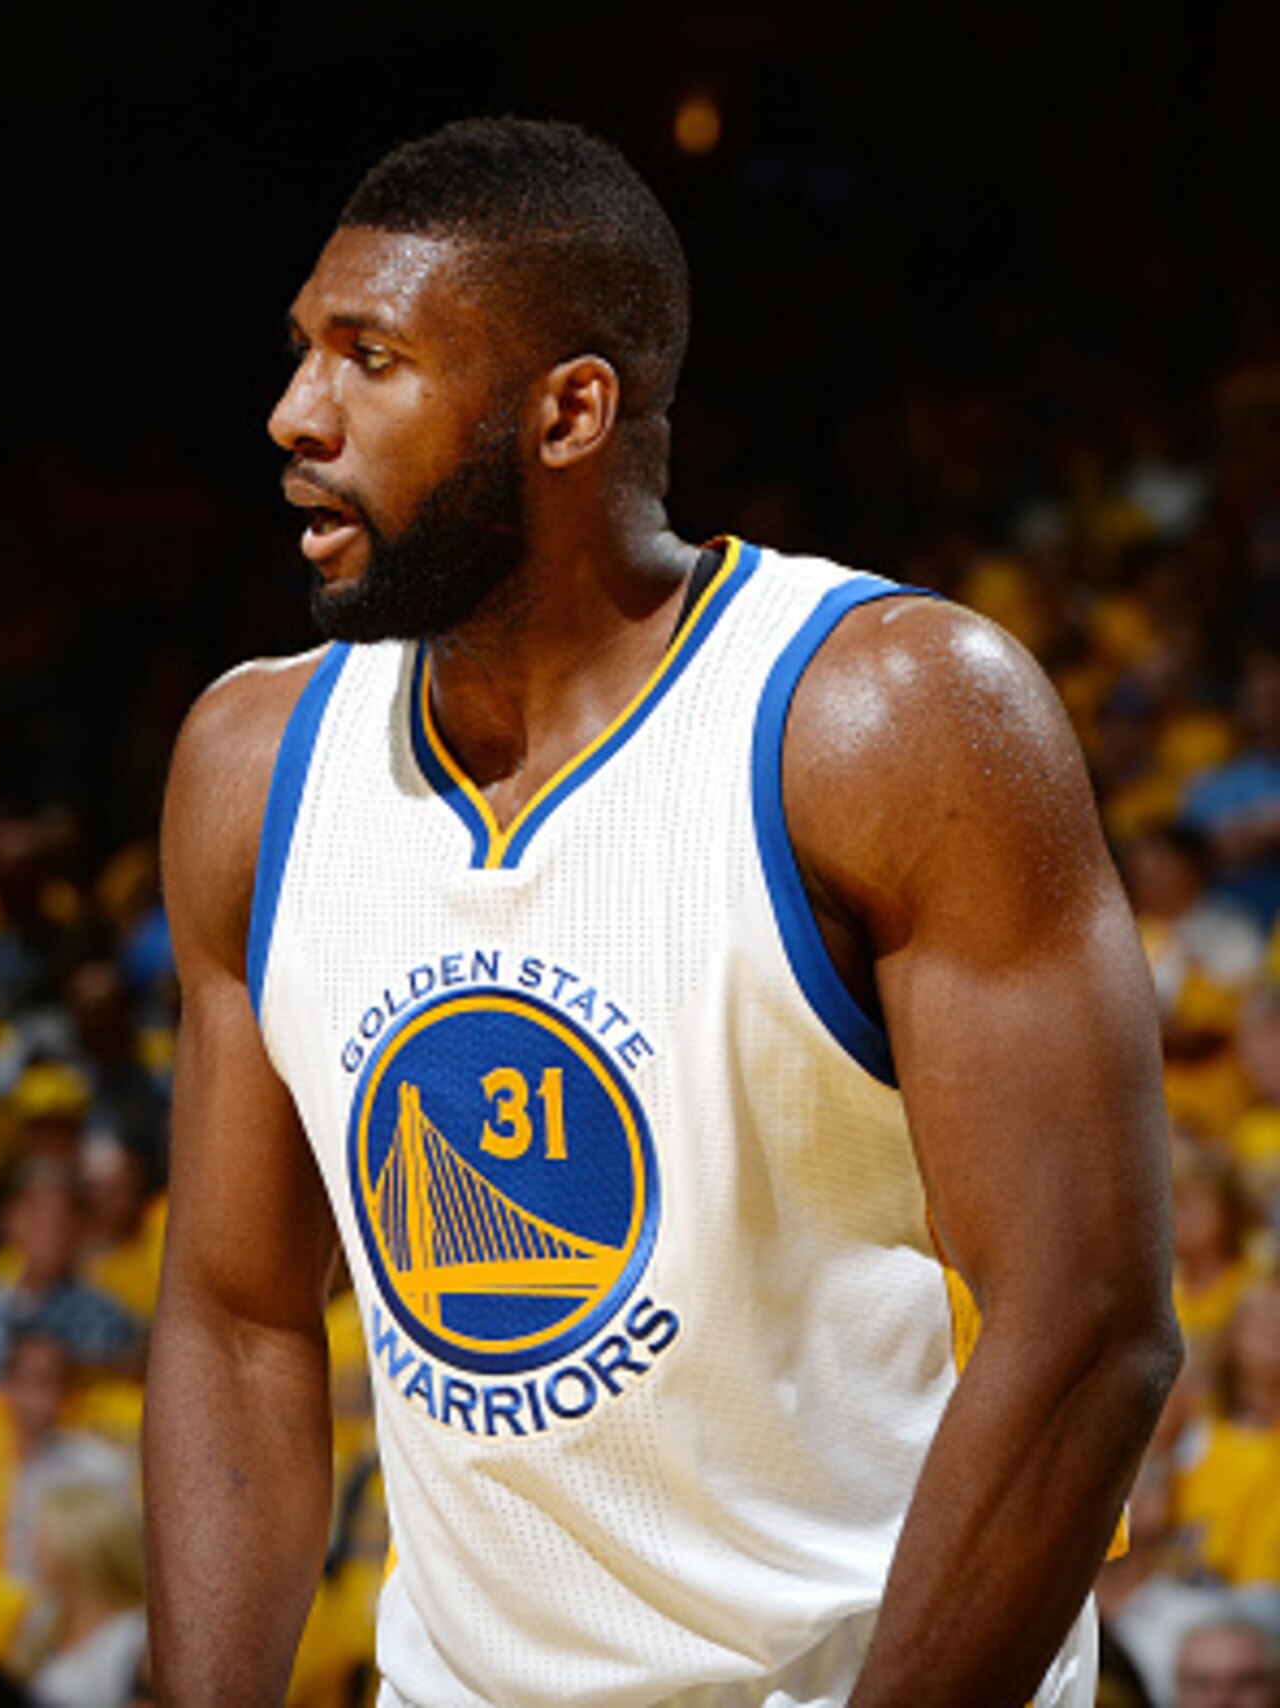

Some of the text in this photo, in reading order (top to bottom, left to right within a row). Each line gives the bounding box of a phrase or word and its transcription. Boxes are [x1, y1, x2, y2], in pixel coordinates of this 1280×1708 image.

[340, 950, 655, 1075] GOLDEN STATE
[479, 1067, 568, 1160] 31
[371, 1298, 680, 1437] WARRIORS
